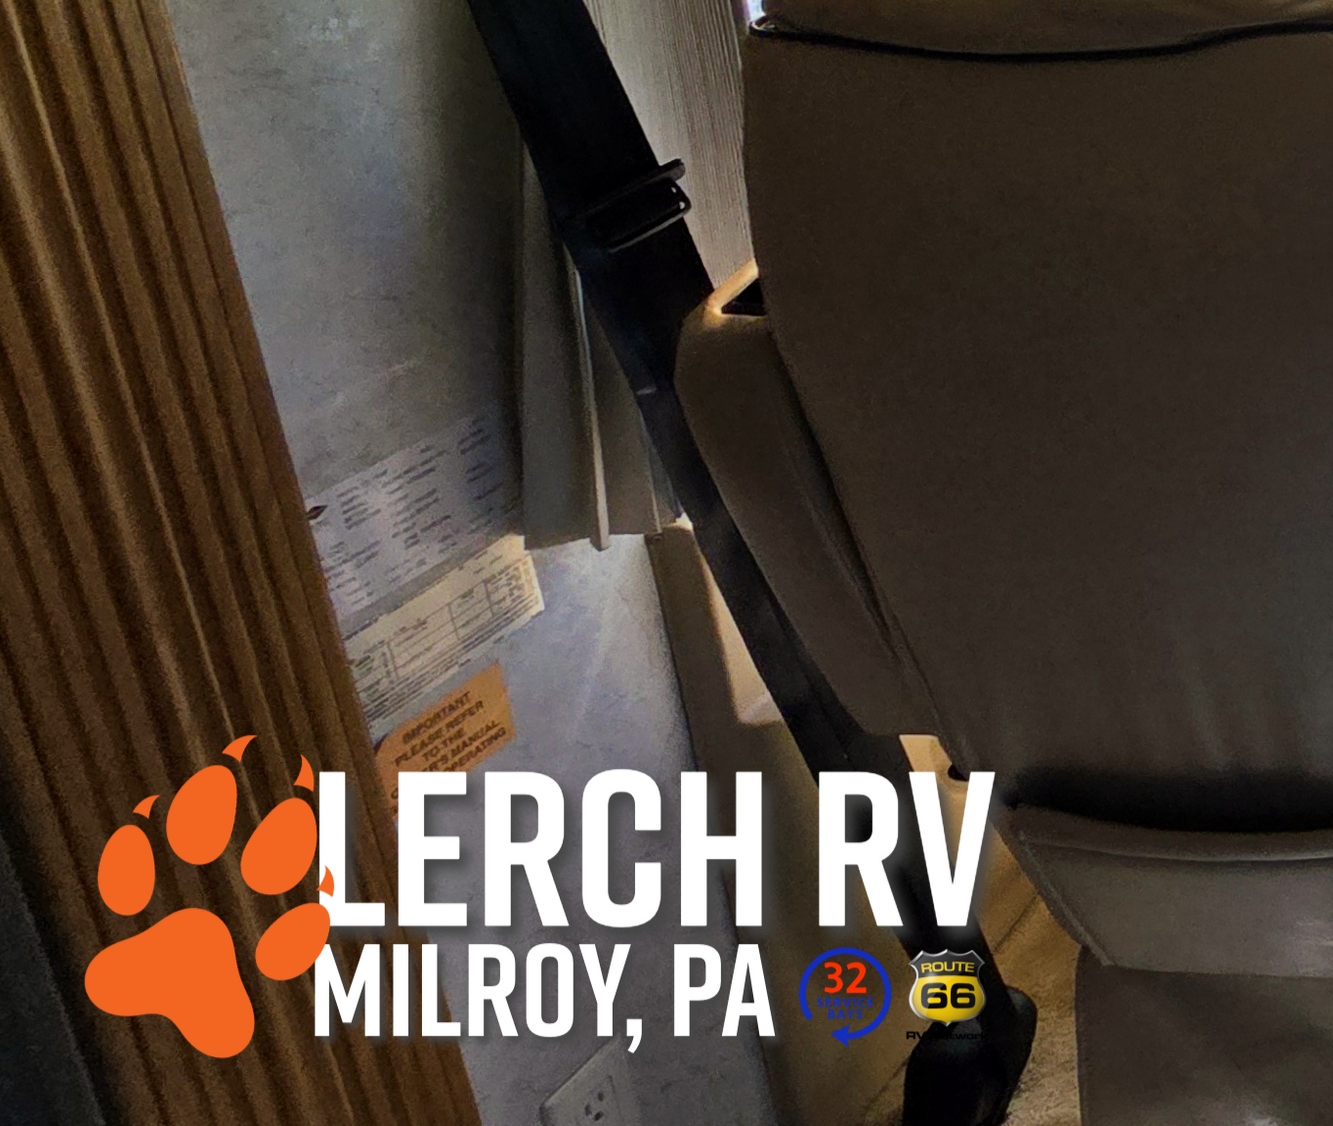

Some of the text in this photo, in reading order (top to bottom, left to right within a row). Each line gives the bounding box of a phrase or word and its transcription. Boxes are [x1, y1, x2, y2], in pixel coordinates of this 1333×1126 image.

[394, 700, 484, 767] PLEASE REFER
[402, 691, 470, 744] IMPORTANT
[450, 720, 501, 756] MANUAL
[422, 728, 465, 762] TO THE
[443, 726, 507, 772] OPERATING
